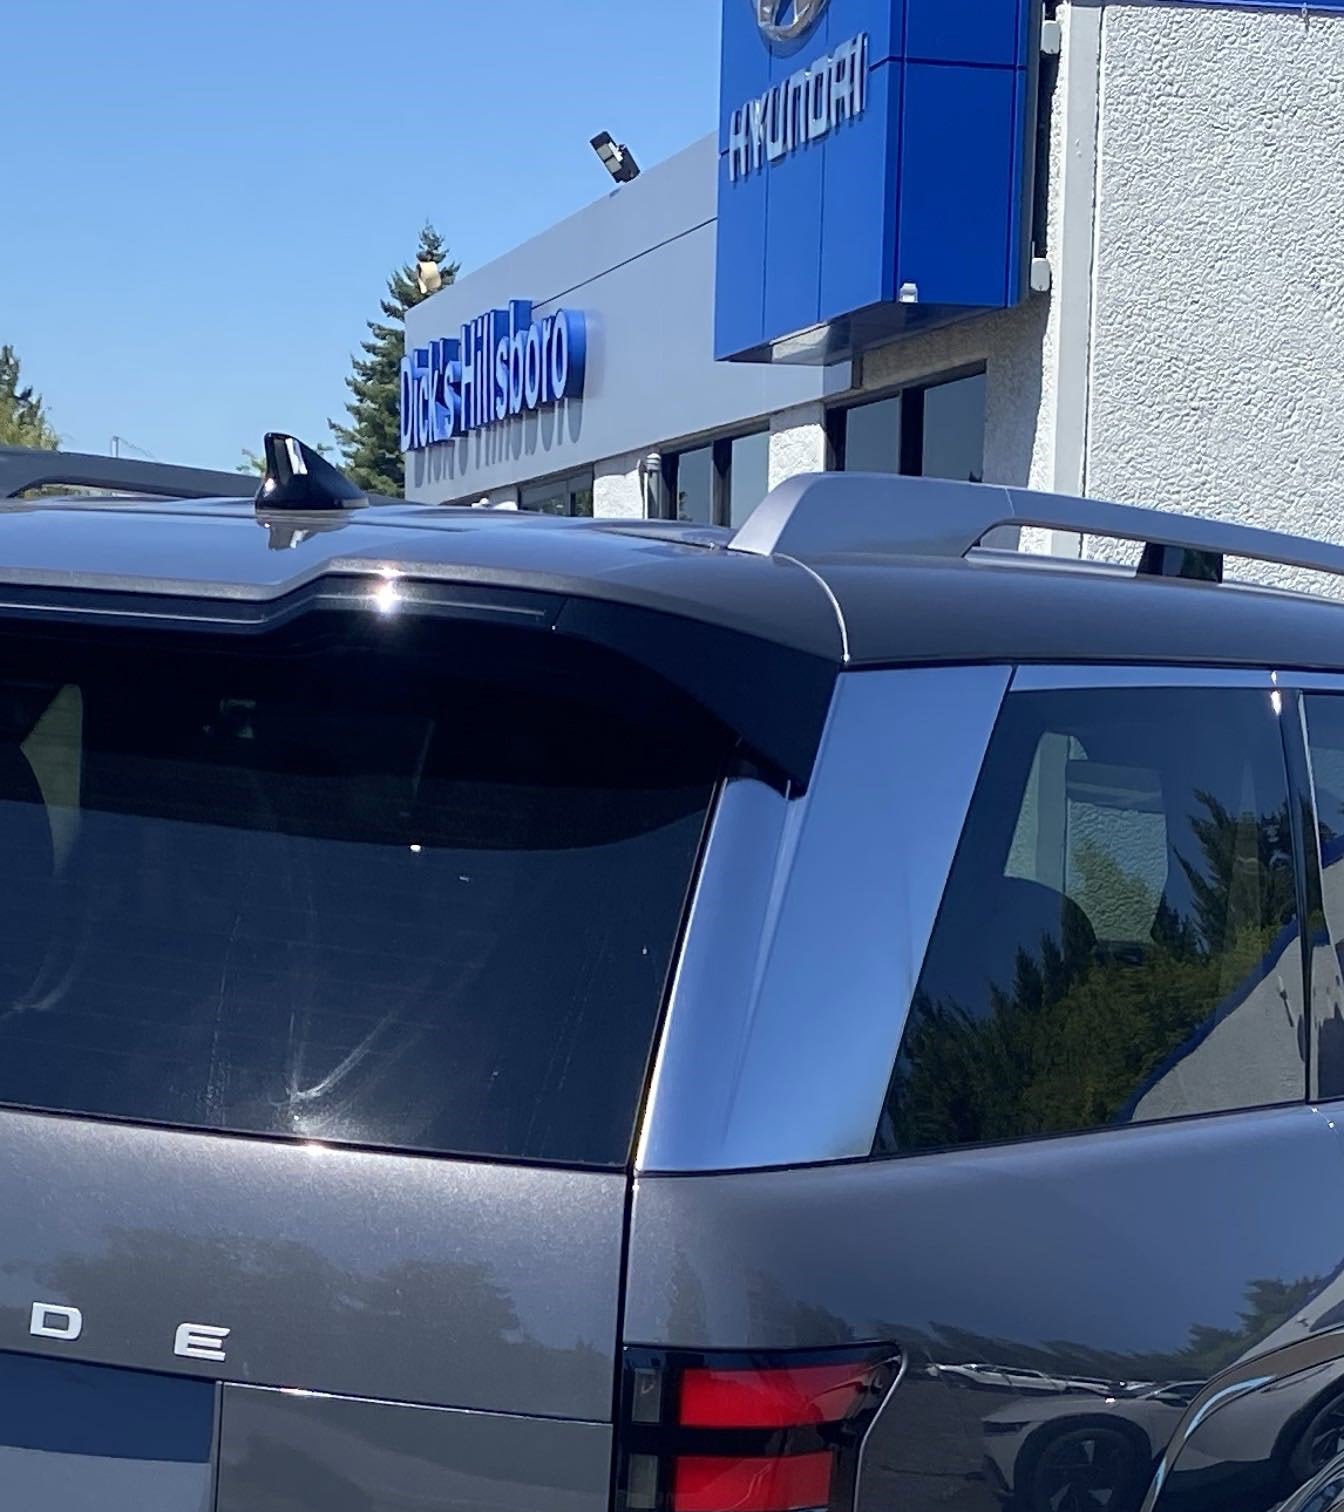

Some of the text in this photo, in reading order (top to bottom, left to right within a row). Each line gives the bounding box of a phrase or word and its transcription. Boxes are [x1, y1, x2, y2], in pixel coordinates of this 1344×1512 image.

[729, 32, 868, 182] HYUNDAI
[400, 299, 570, 451] Dick's Hillsboro
